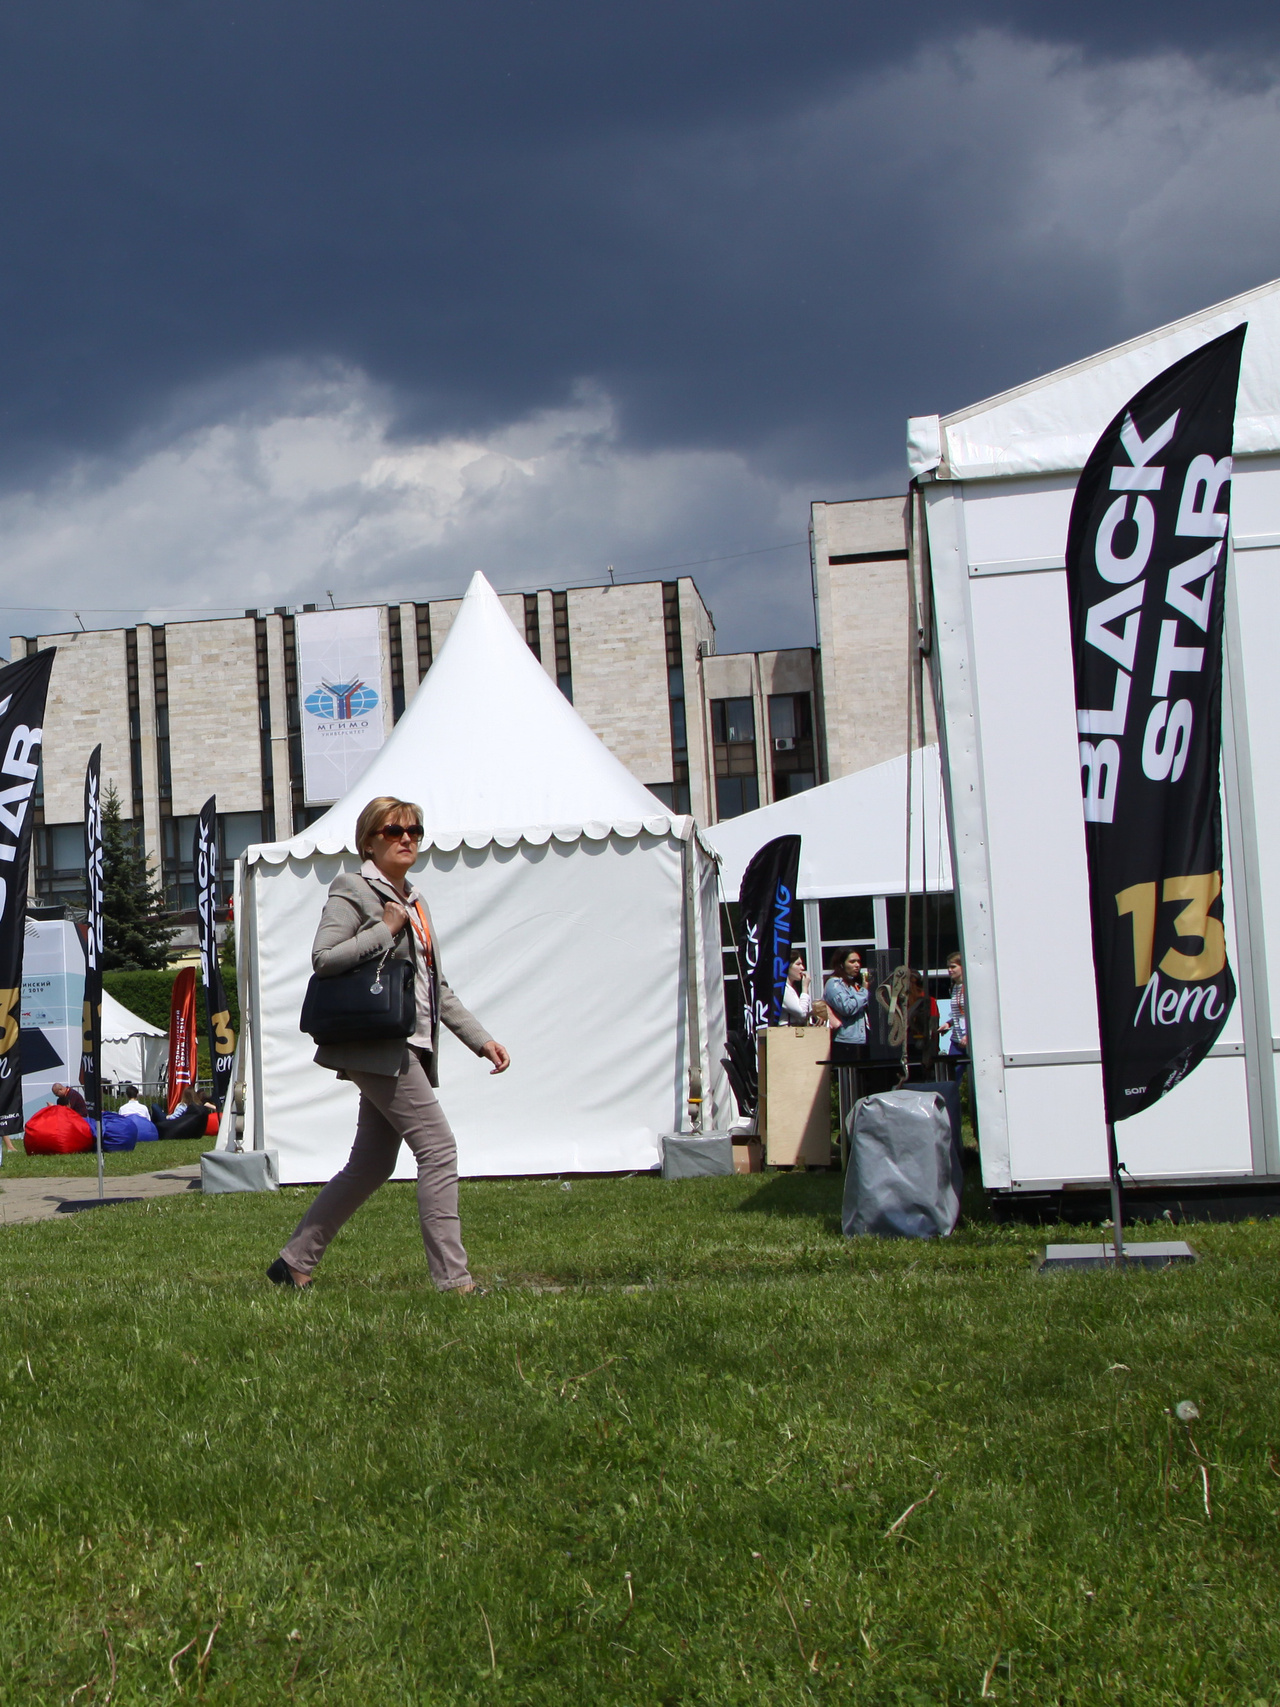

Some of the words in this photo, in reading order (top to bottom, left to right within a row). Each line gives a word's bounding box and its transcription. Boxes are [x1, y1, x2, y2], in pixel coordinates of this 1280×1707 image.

[1077, 406, 1182, 823] BLACK
[1141, 453, 1233, 783] STAR
[317, 721, 369, 730] МГИМО
[321, 729, 365, 737] УНИВЕРСИТЕТ
[1115, 870, 1226, 987] 13
[176, 1070, 191, 1085] II
